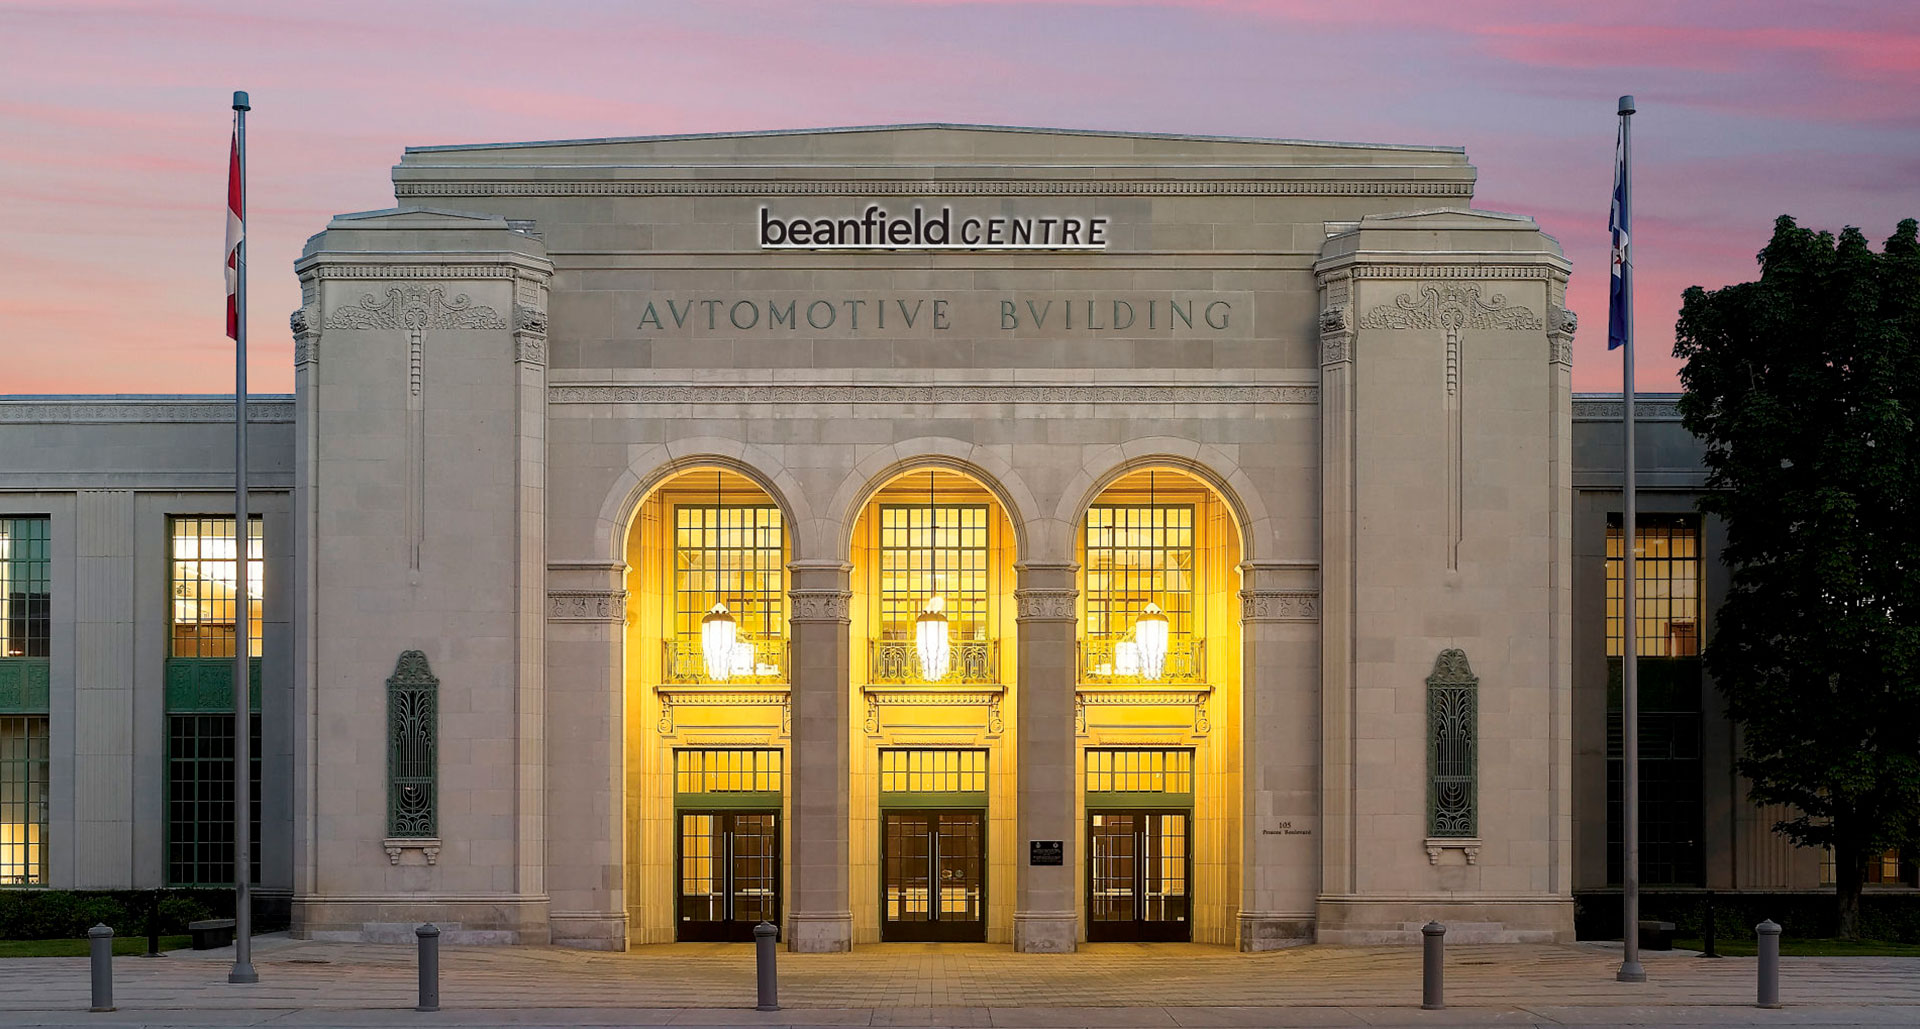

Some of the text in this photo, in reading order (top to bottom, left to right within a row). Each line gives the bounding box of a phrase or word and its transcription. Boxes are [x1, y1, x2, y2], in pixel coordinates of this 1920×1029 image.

[761, 205, 1107, 244] beanfield CENTRE
[1279, 821, 1292, 829] 105
